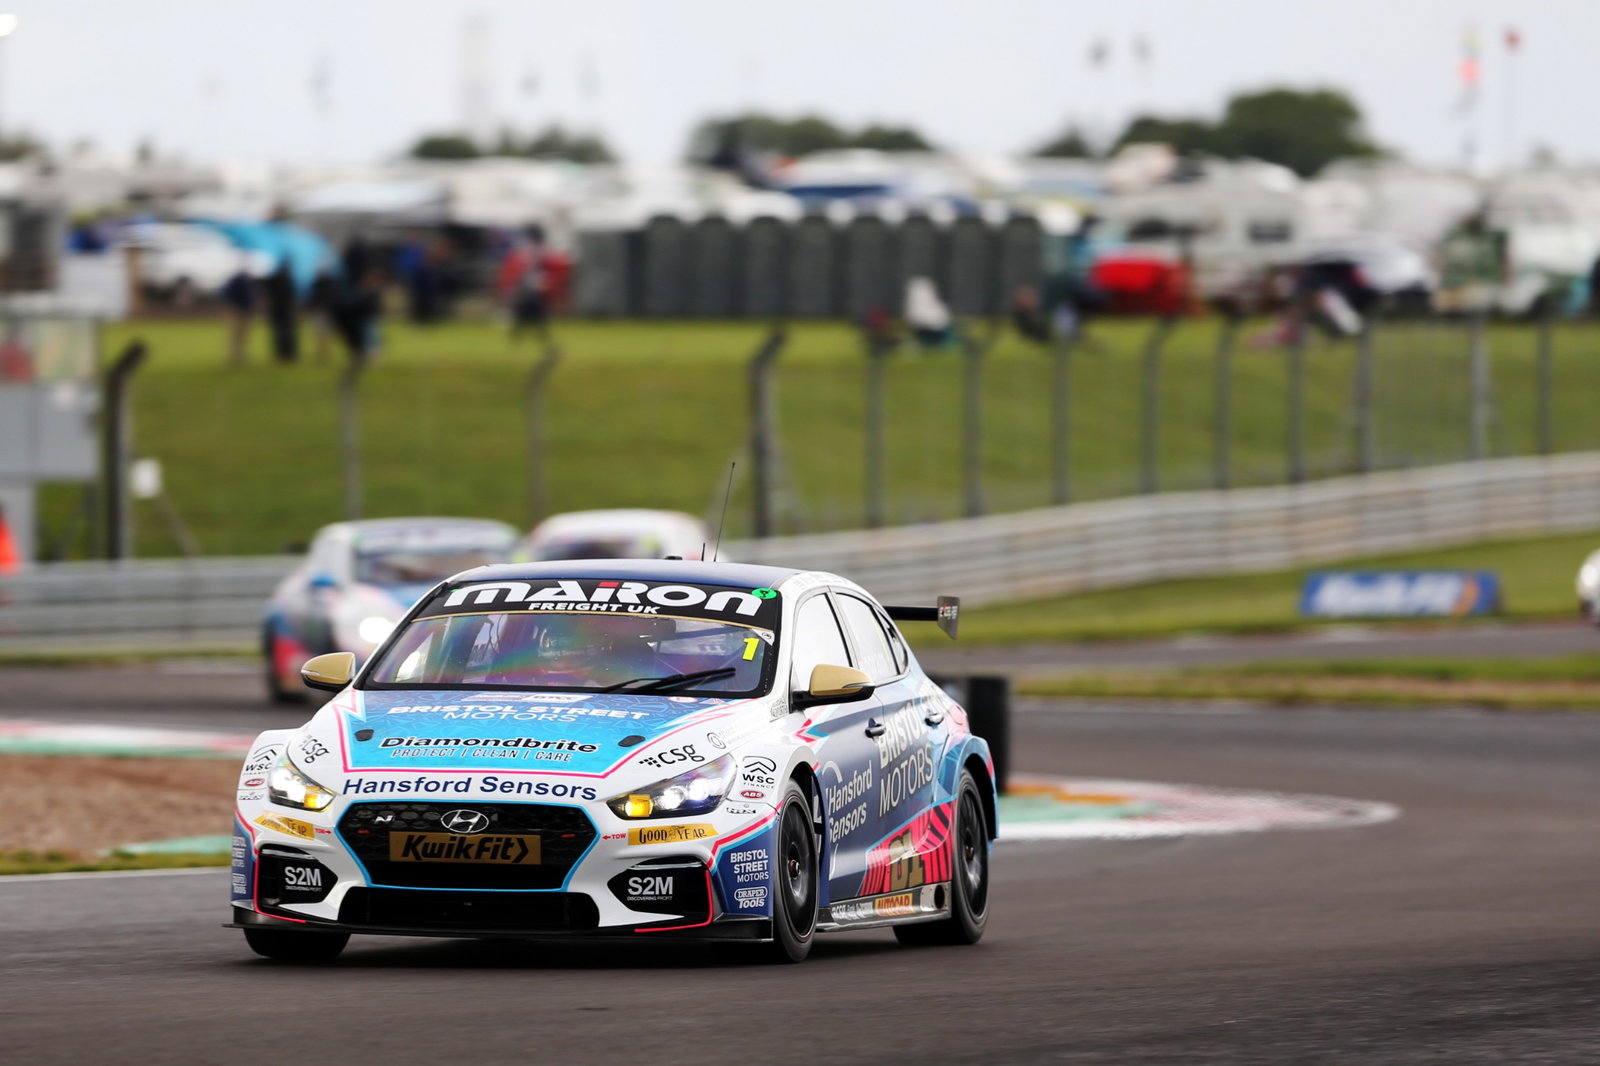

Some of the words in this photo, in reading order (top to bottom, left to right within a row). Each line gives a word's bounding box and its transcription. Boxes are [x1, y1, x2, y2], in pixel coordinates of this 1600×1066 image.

[528, 602, 624, 613] FREIGHT
[627, 604, 661, 614] UK
[741, 637, 760, 661] 1
[387, 705, 515, 715] BRISTOL
[525, 706, 650, 720] STREET
[443, 712, 579, 723] MOTORS
[380, 737, 598, 754] Diamondbrite
[392, 748, 456, 758] PROTECT
[472, 749, 518, 759] CLEAN
[533, 751, 573, 762] CARE
[245, 762, 273, 772] WSC
[742, 774, 775, 785] WSC
[878, 744, 935, 818] MOTORS
[342, 777, 472, 795] Hansford
[479, 776, 597, 800] Sensors
[828, 760, 873, 816] Hansford
[730, 849, 769, 863] BRISTOL
[733, 860, 769, 874] STREET
[285, 866, 322, 887] S2M
[736, 871, 770, 883] MOTORS
[627, 876, 674, 896] S2M
[737, 889, 765, 899] DRAPER
